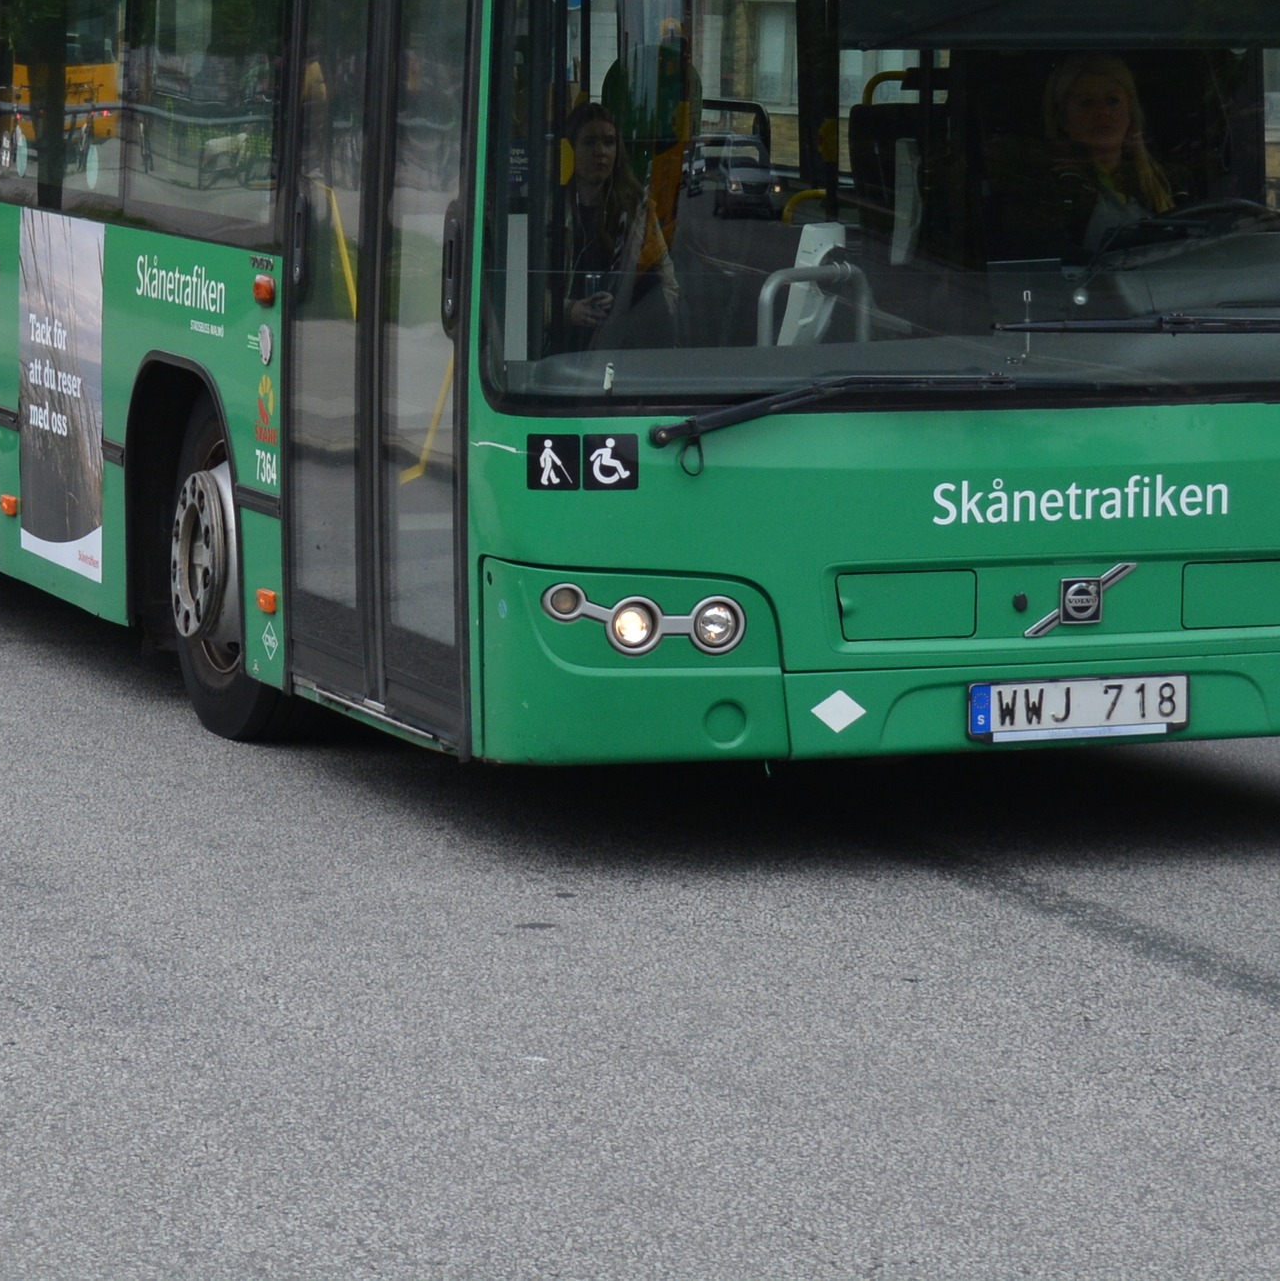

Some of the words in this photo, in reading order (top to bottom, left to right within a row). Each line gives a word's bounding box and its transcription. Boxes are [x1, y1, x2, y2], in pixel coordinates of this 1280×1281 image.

[135, 254, 225, 314] Skånetrafiken
[29, 313, 52, 347] Tack
[53, 317, 67, 351] för
[29, 360, 43, 386] att
[43, 358, 56, 391] du
[57, 374, 81, 399] reser
[29, 401, 50, 431] med
[51, 410, 67, 437] oss
[255, 449, 277, 486] 7364
[932, 474, 1229, 526] Skånetrafiken
[1067, 597, 1098, 605] VOLVO
[977, 714, 985, 725] S
[996, 686, 1072, 727] WWJ
[1103, 682, 1177, 721] 718
